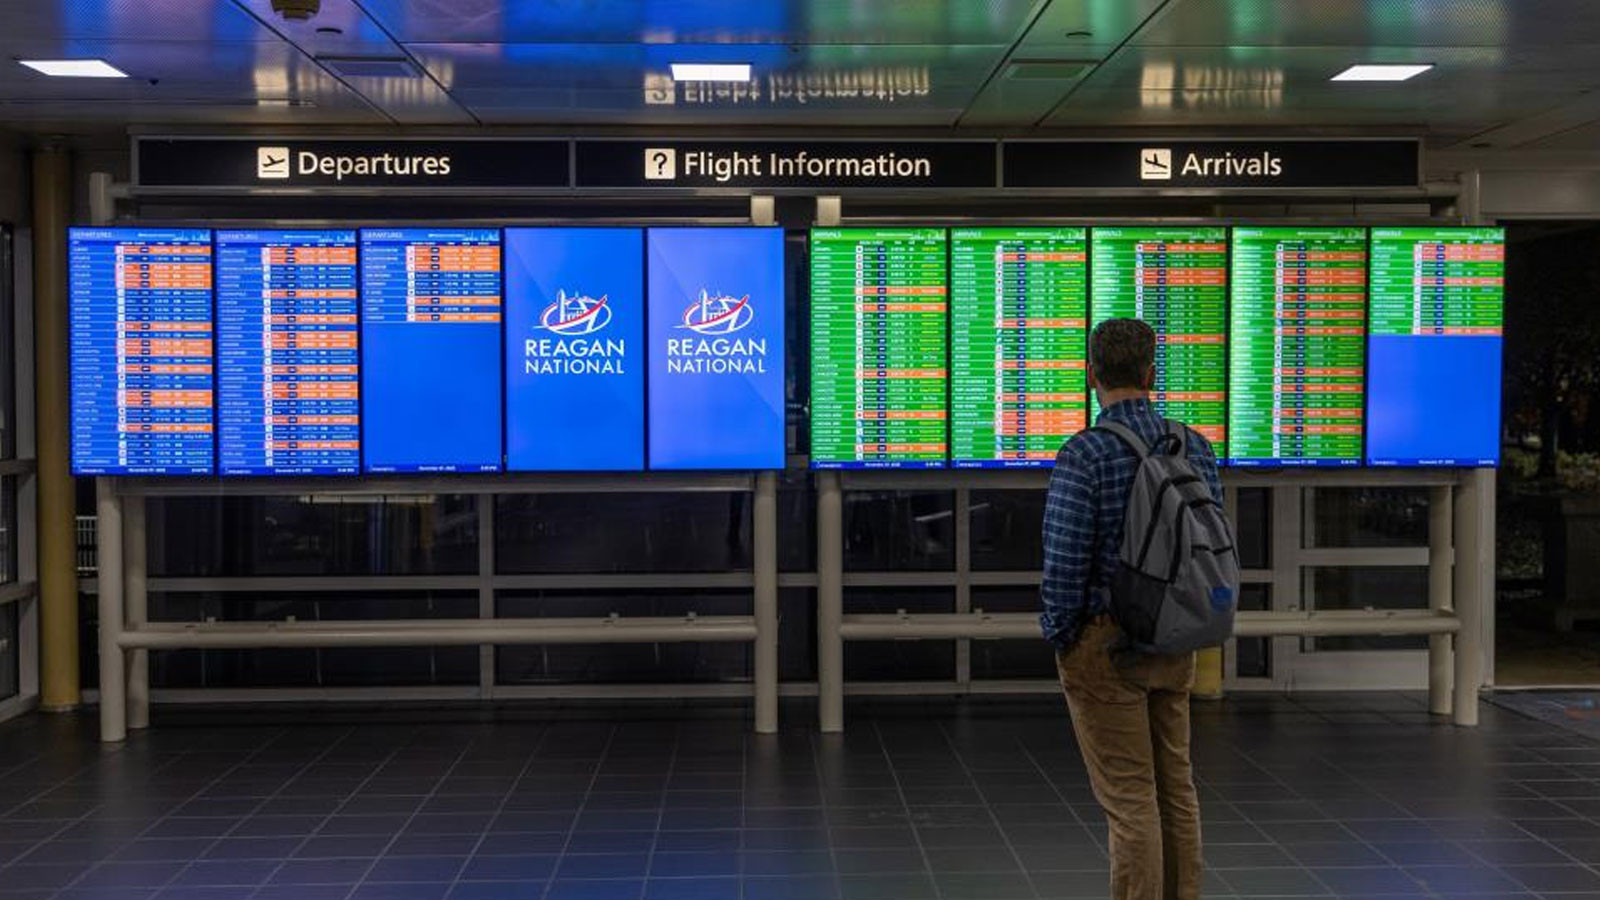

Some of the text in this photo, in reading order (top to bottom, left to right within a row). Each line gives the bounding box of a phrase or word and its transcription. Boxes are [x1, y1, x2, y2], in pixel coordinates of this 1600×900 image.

[298, 152, 451, 180] Departures
[685, 152, 931, 181] Flight Information
[1181, 152, 1282, 176] Arrivals
[525, 338, 625, 357] REAGAN
[667, 338, 766, 356] REAGAN
[525, 358, 625, 374] NATIONAL
[667, 358, 766, 374] NATIONAL
